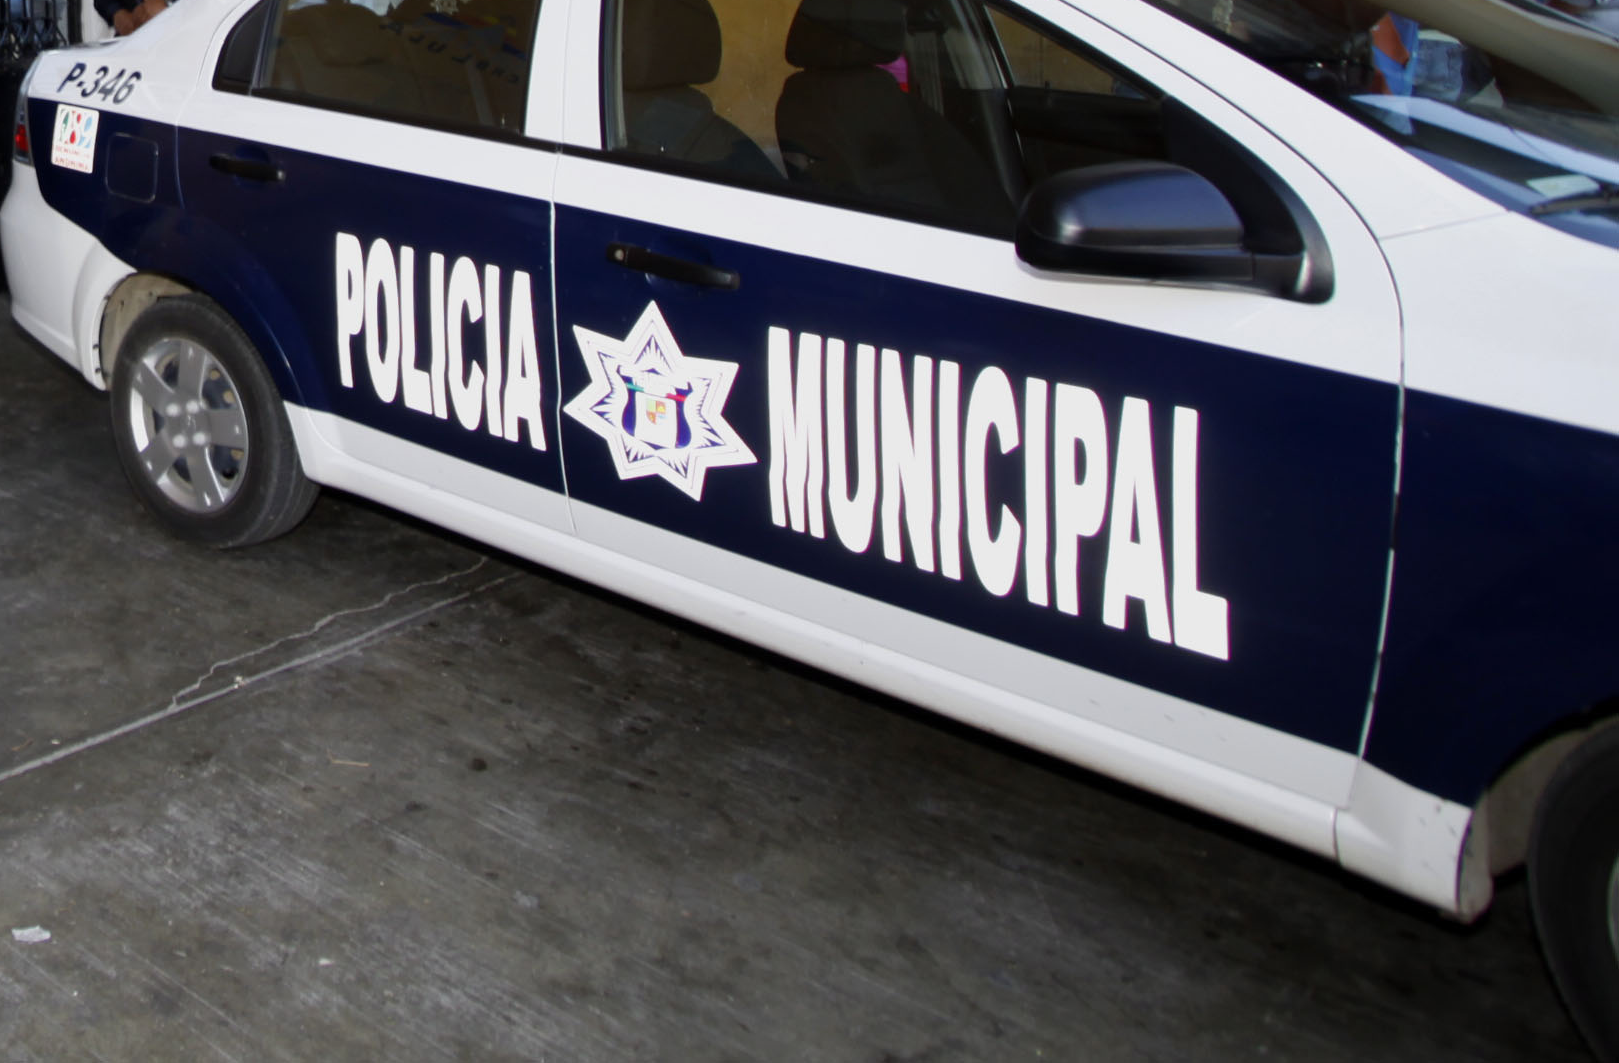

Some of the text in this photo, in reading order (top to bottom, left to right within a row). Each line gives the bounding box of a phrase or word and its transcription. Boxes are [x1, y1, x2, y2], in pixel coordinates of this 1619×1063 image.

[57, 62, 142, 105] P-346
[335, 231, 1229, 661] POLICIA MUNICIPAL
